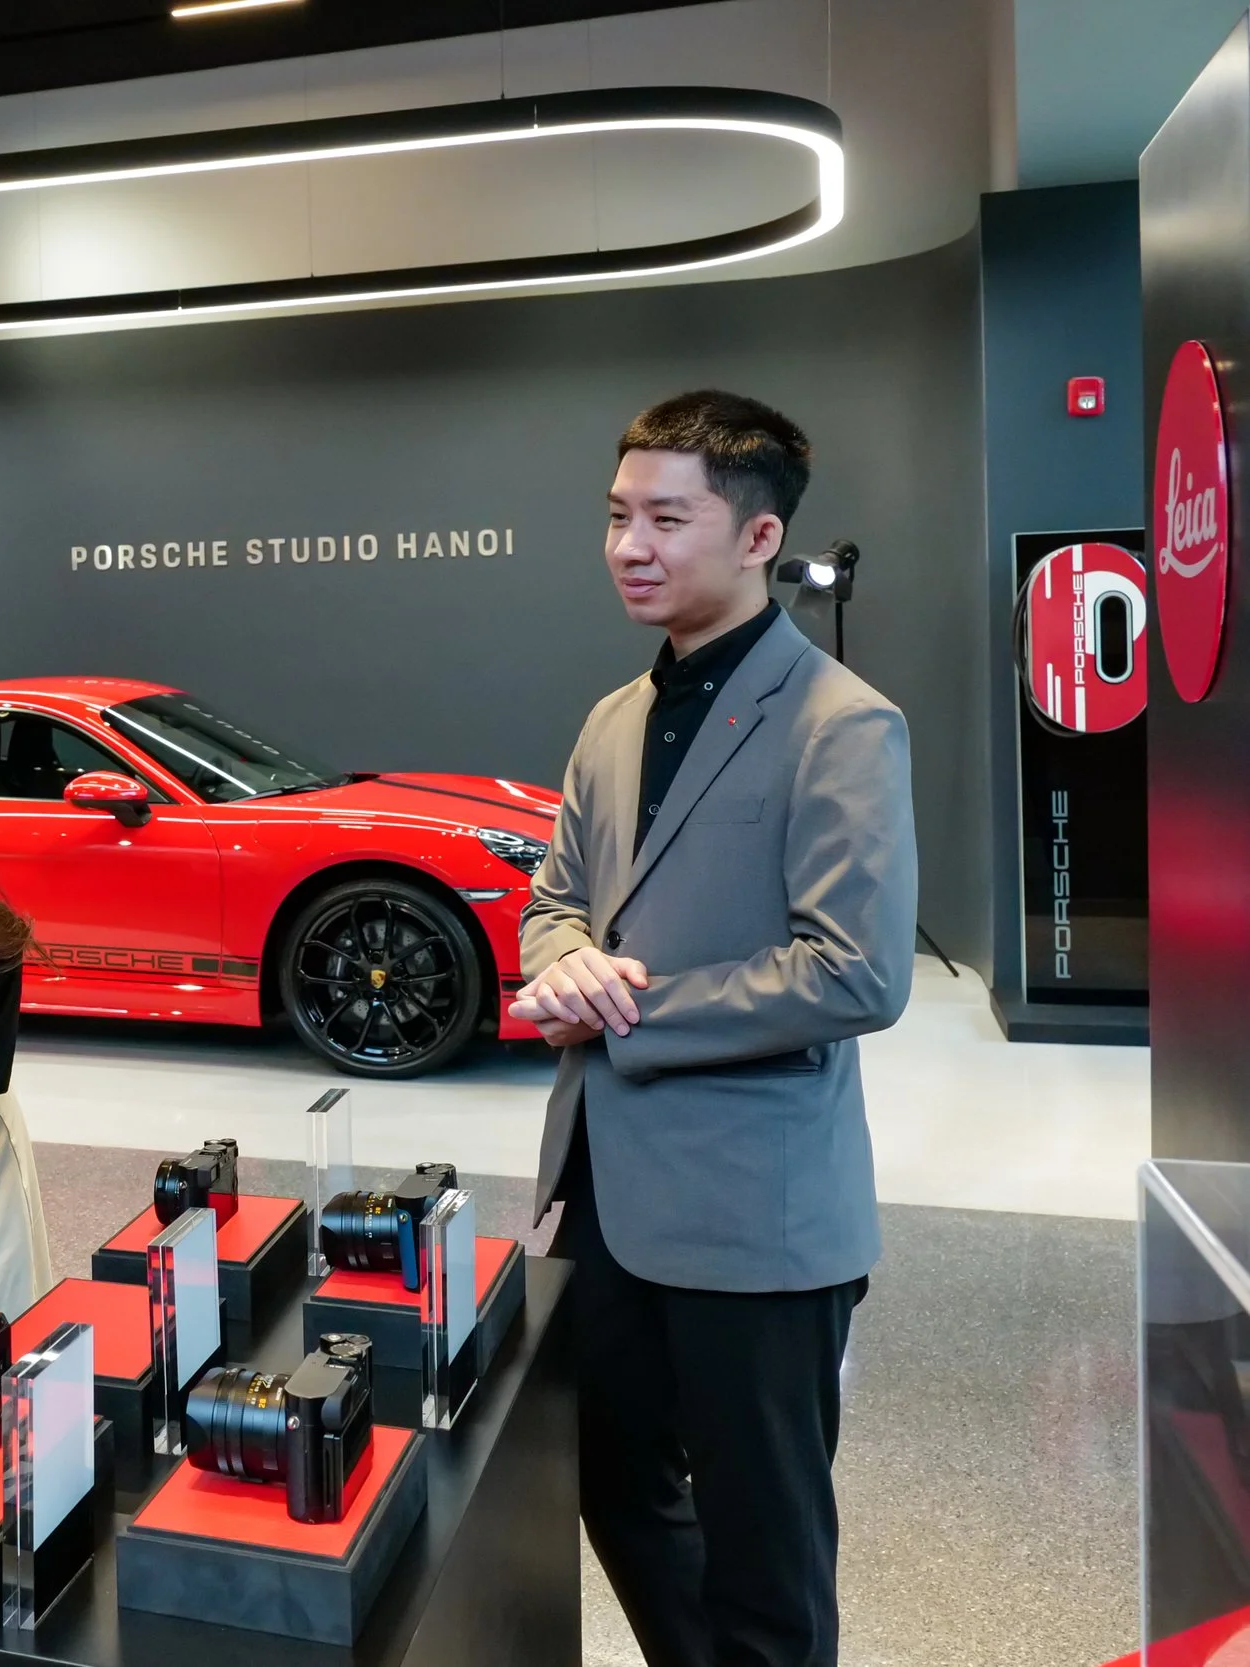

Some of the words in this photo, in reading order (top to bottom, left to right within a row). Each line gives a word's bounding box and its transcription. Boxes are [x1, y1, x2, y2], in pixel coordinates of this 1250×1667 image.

[70, 540, 229, 572] PORSCHE
[246, 534, 379, 566] STUDIO
[396, 528, 514, 560] HANOI
[1159, 448, 1218, 578] Leica
[1072, 573, 1086, 686] PORSCHE
[1051, 790, 1072, 979] PORSCHE
